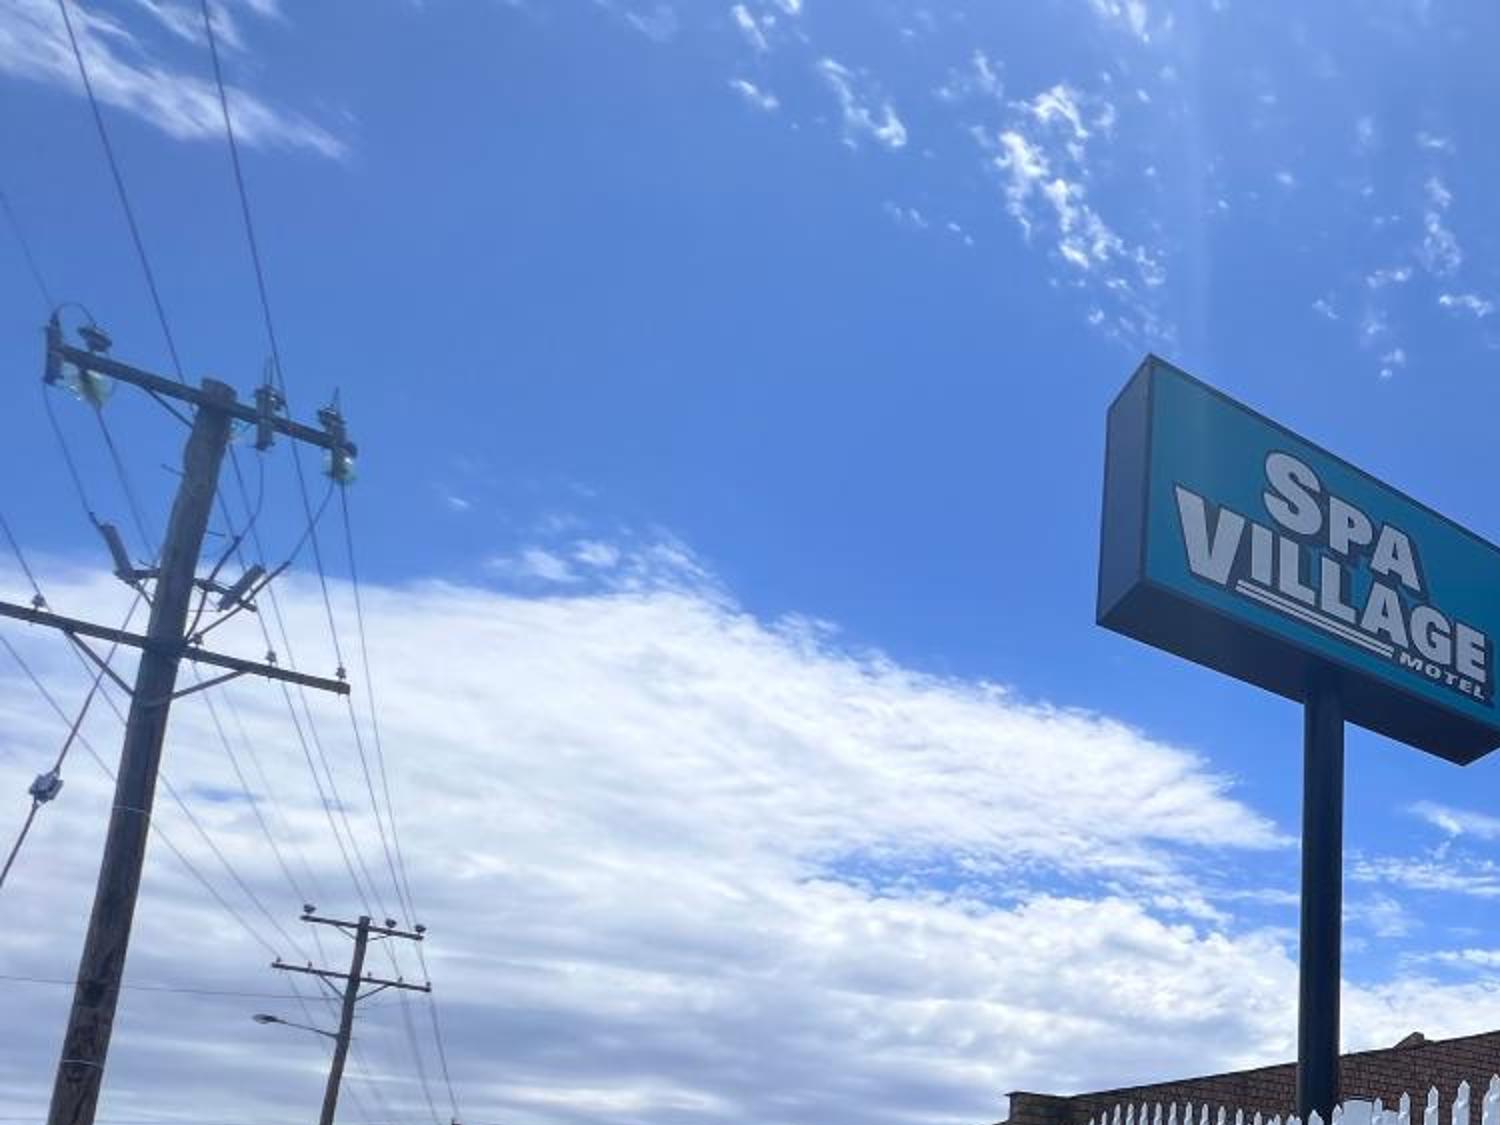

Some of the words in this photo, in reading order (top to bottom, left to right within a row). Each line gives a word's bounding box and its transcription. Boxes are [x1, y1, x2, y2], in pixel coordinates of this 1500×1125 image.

[1174, 485, 1487, 683] VILLAGE
[1263, 451, 1421, 592] SPA
[1400, 652, 1486, 701] MOTEL
